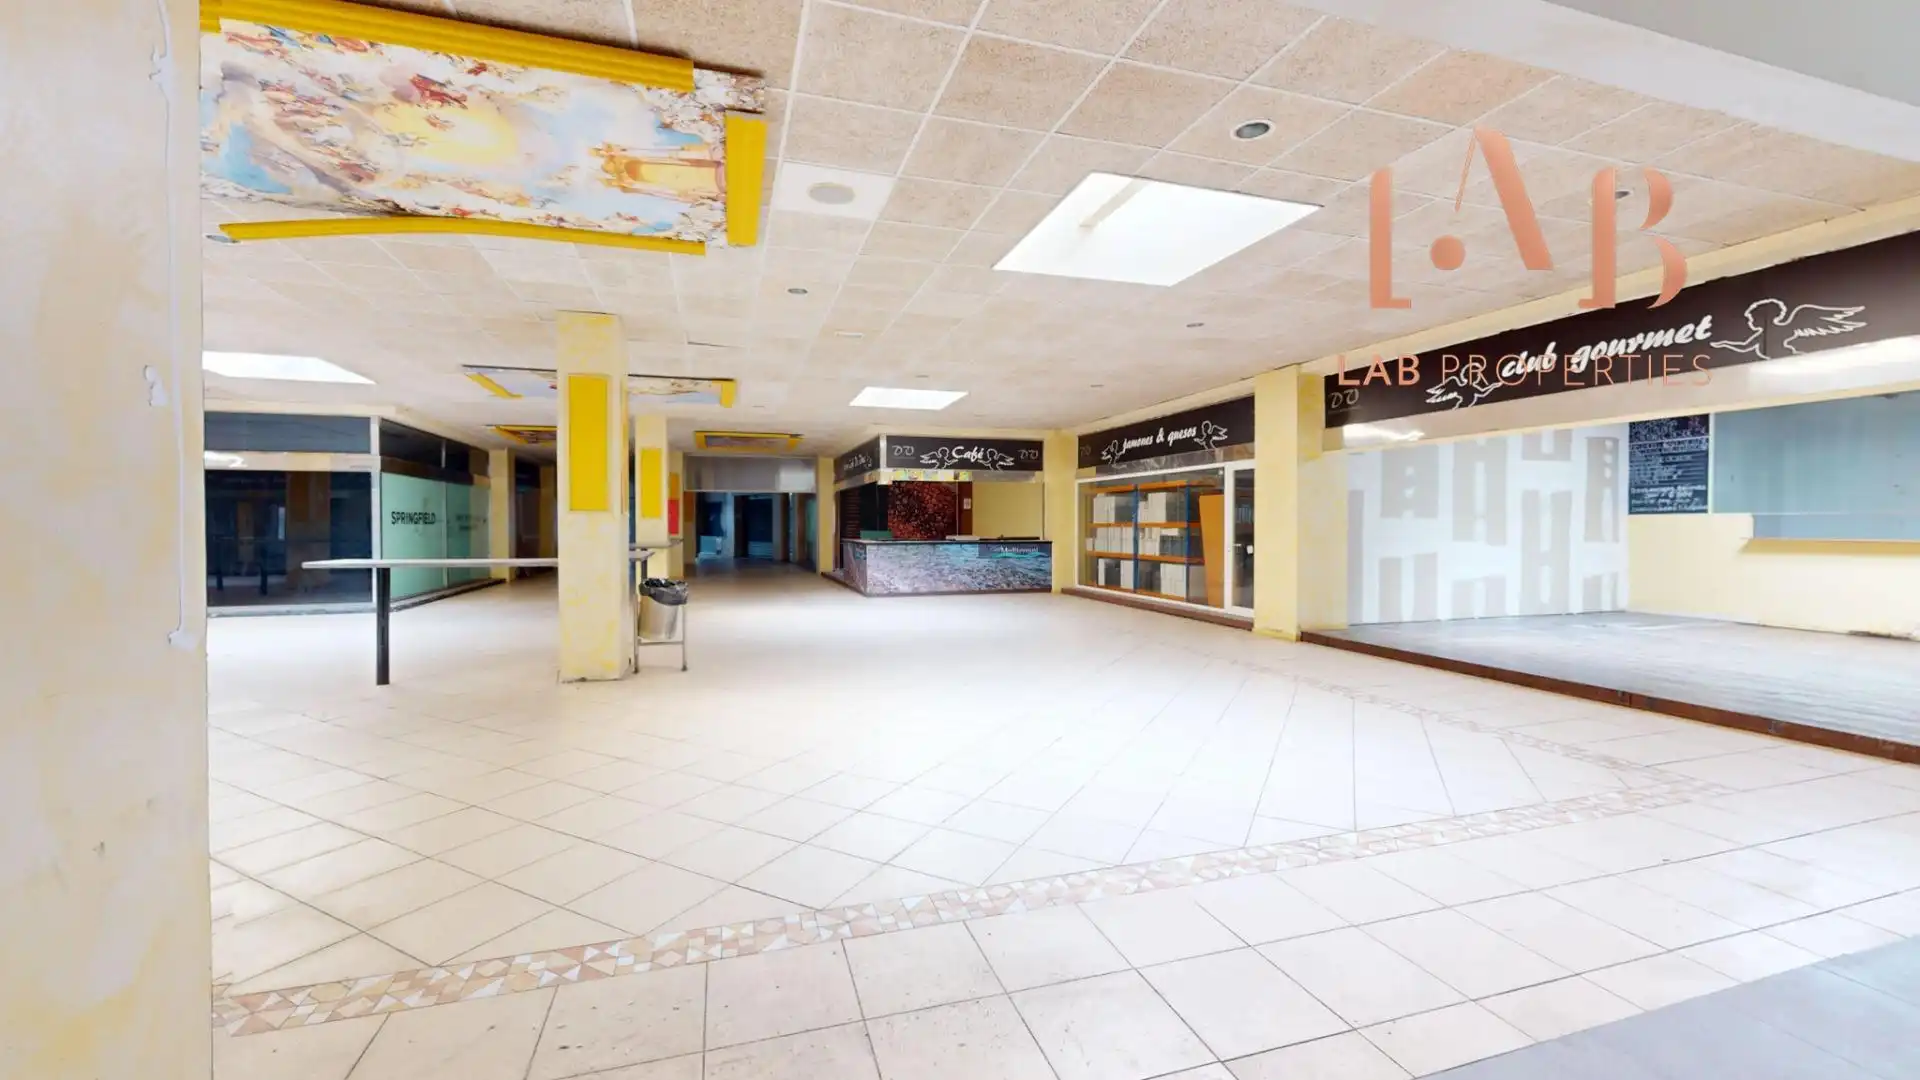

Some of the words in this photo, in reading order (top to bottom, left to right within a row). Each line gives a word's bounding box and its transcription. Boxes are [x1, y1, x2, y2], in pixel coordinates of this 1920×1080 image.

[1502, 342, 1556, 378] club
[1571, 315, 1712, 372] gourmet
[1122, 437, 1153, 453] jamones
[1156, 427, 1165, 443] &
[1167, 426, 1198, 446] quesos
[952, 446, 984, 462] Café
[391, 511, 436, 524] SPRINGFIELD
